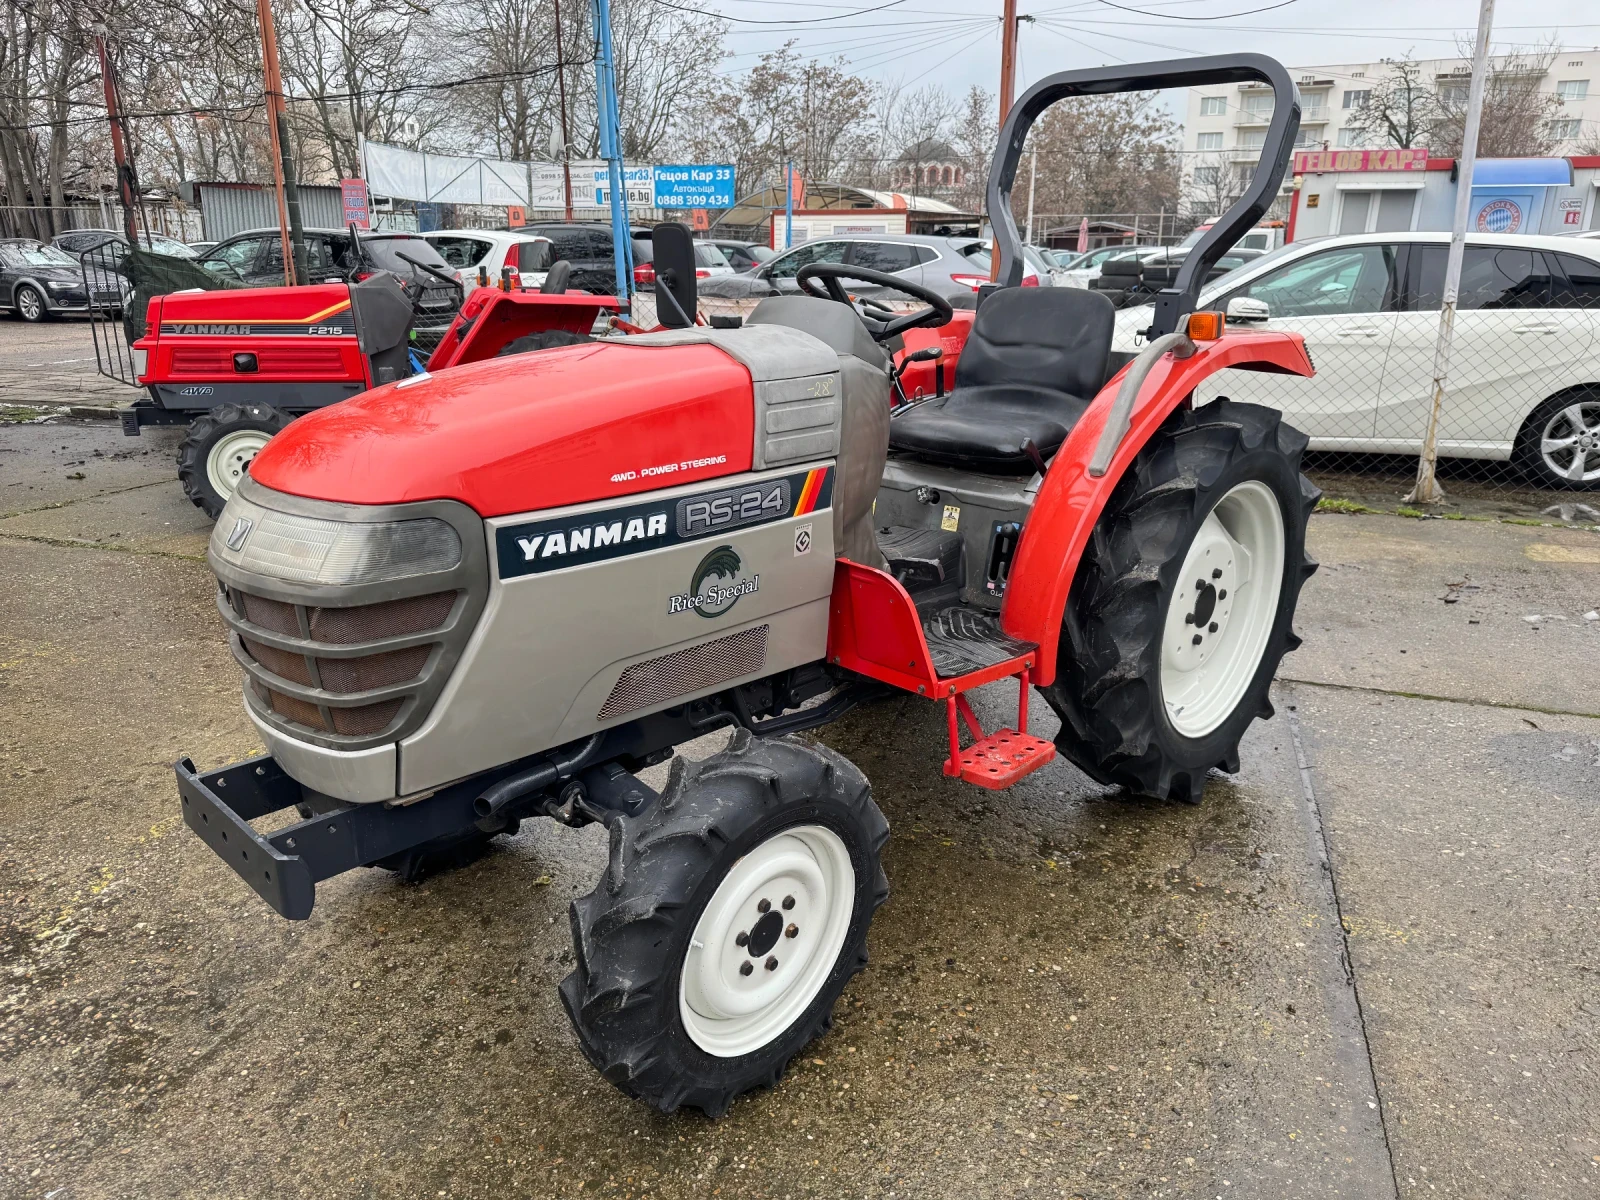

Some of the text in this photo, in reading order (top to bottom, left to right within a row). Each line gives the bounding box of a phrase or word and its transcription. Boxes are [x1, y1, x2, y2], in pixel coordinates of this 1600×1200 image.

[1294, 152, 1362, 171] ГЕЦОВ
[1368, 150, 1413, 170] КАР
[655, 169, 730, 182] Гецов Кар 33
[672, 184, 714, 193] Автокъща
[657, 194, 729, 205] 0888 309 434
[172, 324, 343, 335] YANMAR F215
[180, 386, 214, 396] 4WD
[641, 463, 679, 477] POWER
[680, 455, 727, 470] STEERING
[517, 486, 783, 562] YANMAR RS-24
[668, 576, 759, 615] Rice Special
